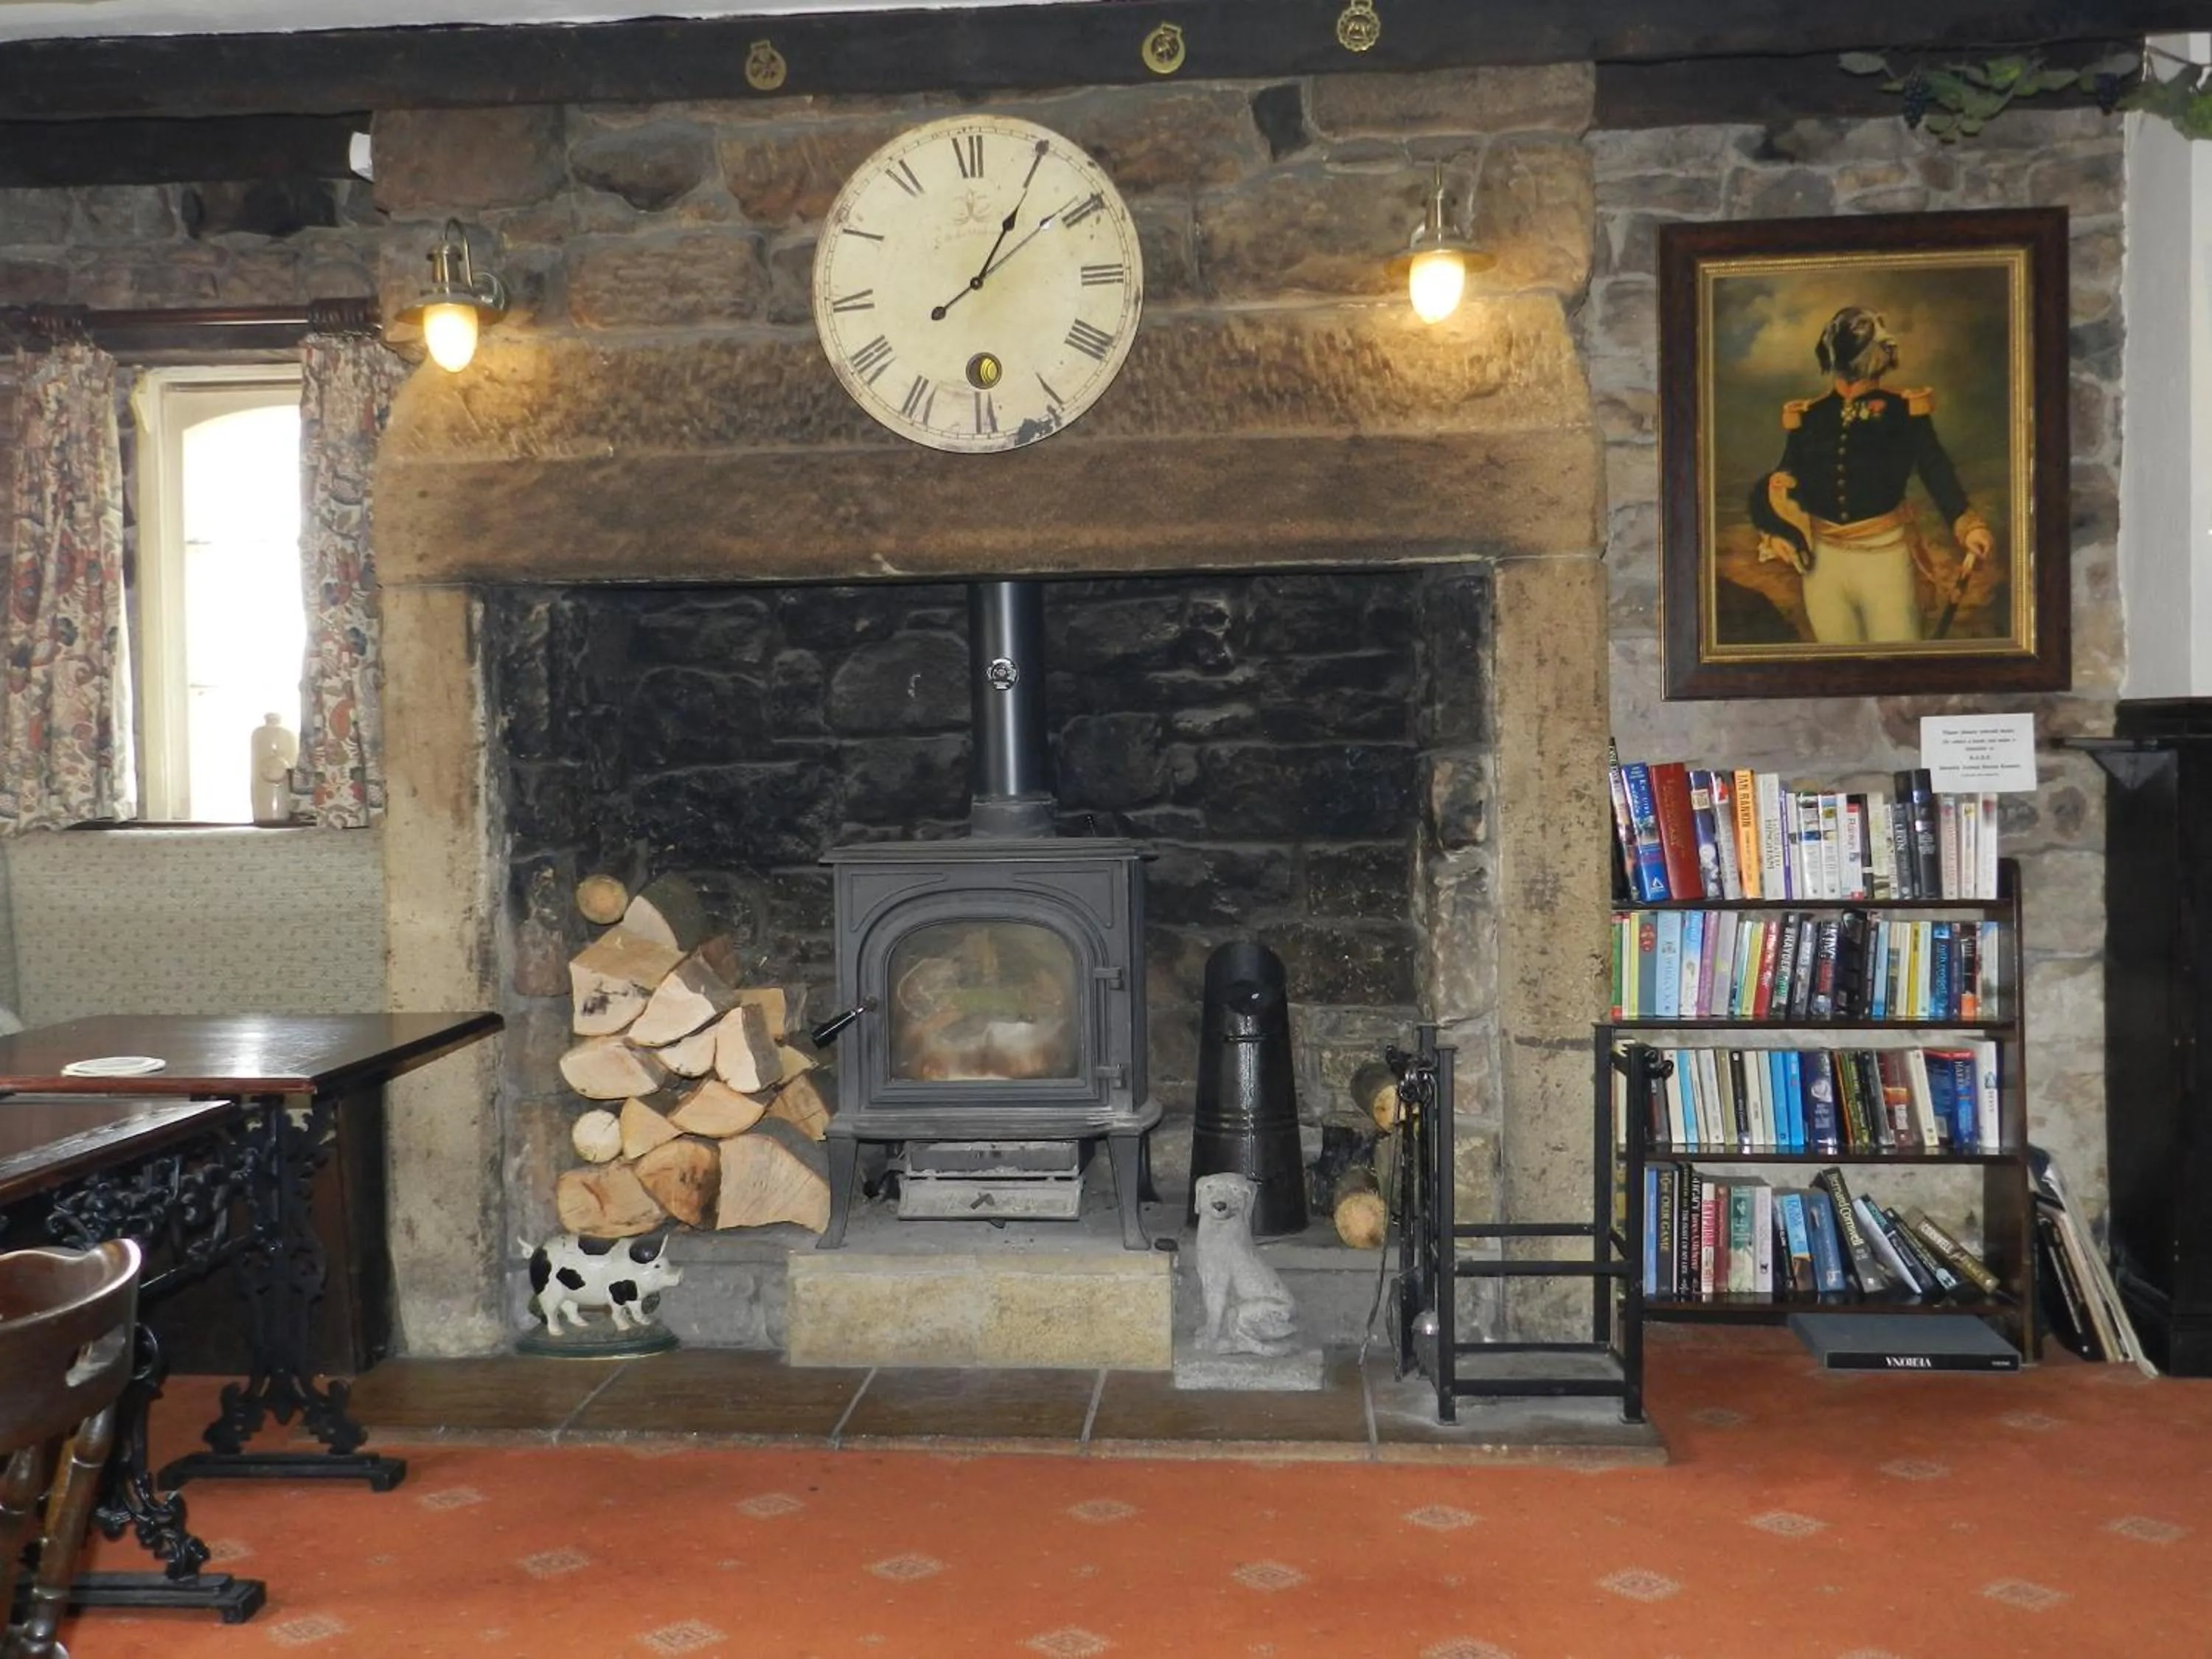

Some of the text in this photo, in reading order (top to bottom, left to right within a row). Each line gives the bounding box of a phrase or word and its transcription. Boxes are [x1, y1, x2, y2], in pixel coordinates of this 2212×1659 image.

[1080, 263, 1124, 286] III
[1736, 773, 1748, 791] IAN
[1739, 792, 1752, 828] RANKIN
[1764, 819, 1774, 869] BINGHAM
[1894, 823, 1905, 852] LEON
[1660, 1195, 1671, 1220] OUR
[1660, 1220, 1670, 1253] GAME
[1840, 1202, 1865, 1247] Cornwell
[1919, 1220, 1955, 1254] CORNWELL
[1885, 1357, 1933, 1368] VERONA
